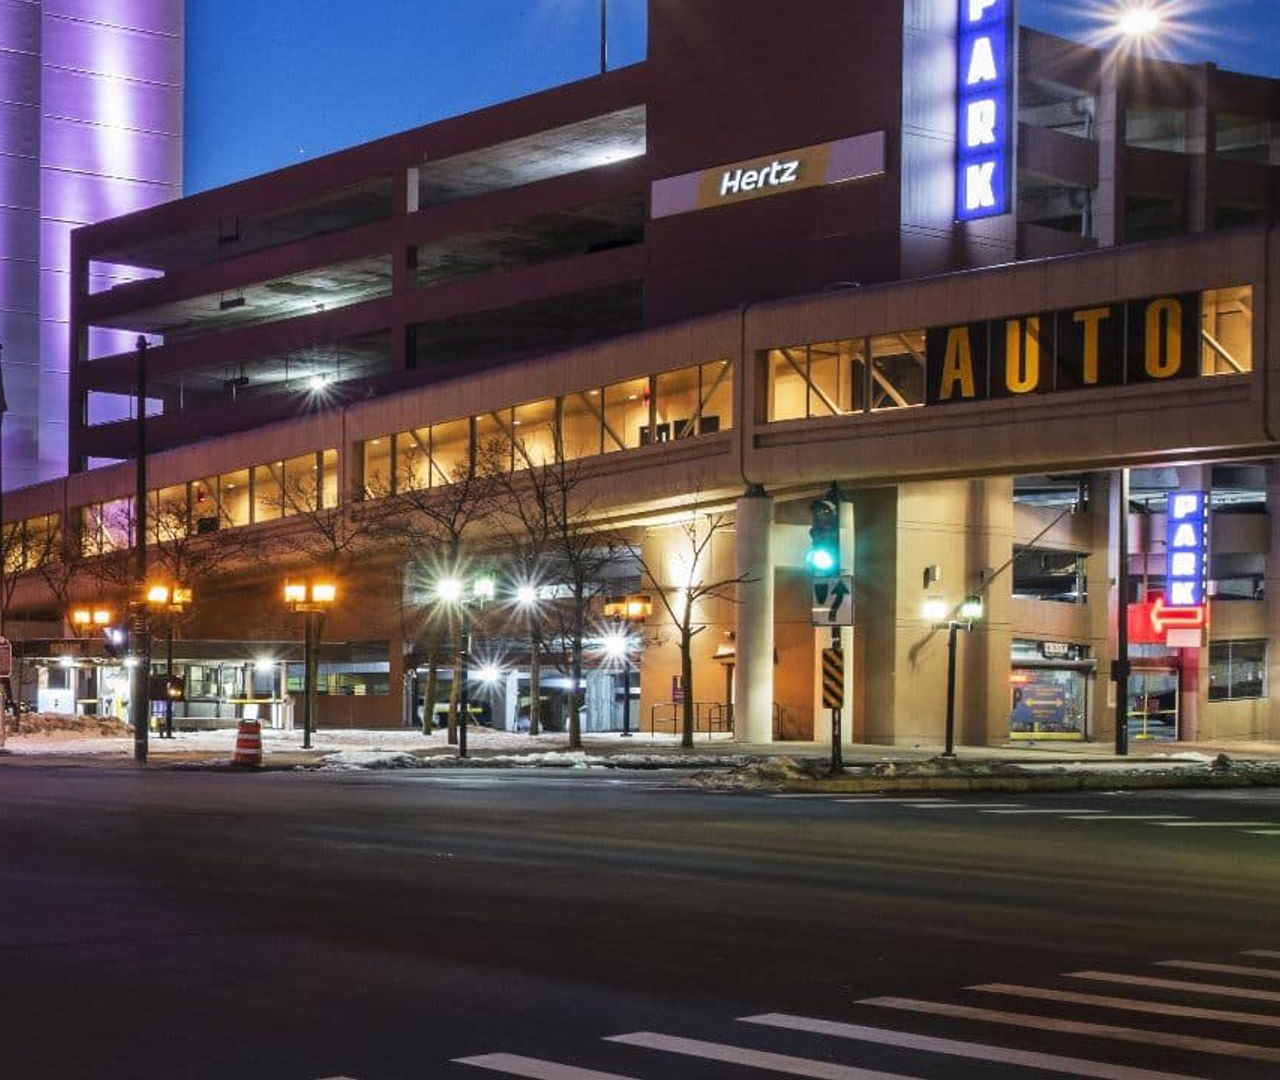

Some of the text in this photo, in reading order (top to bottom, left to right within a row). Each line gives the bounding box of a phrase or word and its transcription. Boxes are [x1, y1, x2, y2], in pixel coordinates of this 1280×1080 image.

[720, 160, 799, 196] Hertz
[939, 298, 1182, 400] AUTO
[1171, 494, 1197, 605] PARK
